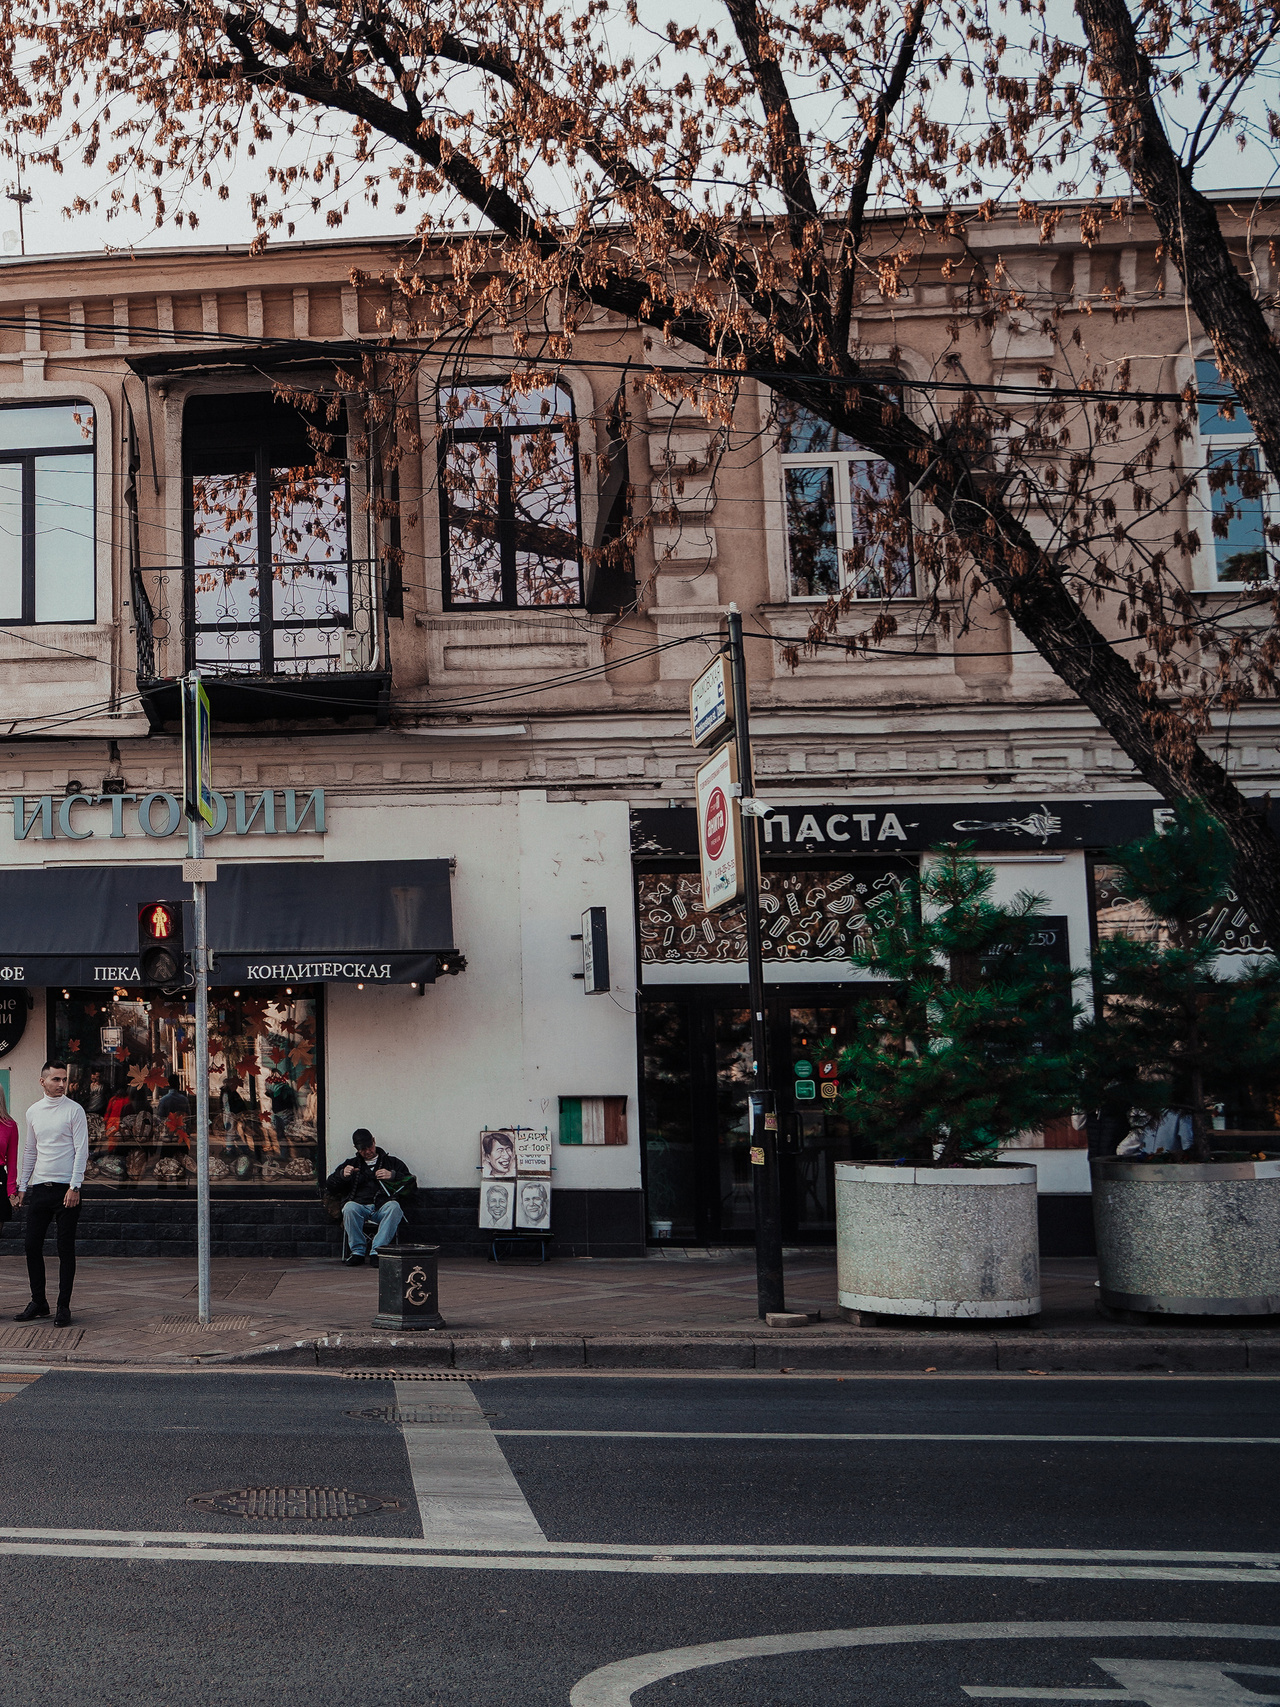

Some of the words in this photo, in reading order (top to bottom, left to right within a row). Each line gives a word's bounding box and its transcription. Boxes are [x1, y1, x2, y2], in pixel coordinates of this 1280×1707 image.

[764, 813, 907, 842] ПАСТА
[94, 966, 141, 981] ПЕКА
[247, 964, 391, 981] КОНДИТЕРСКАЯ
